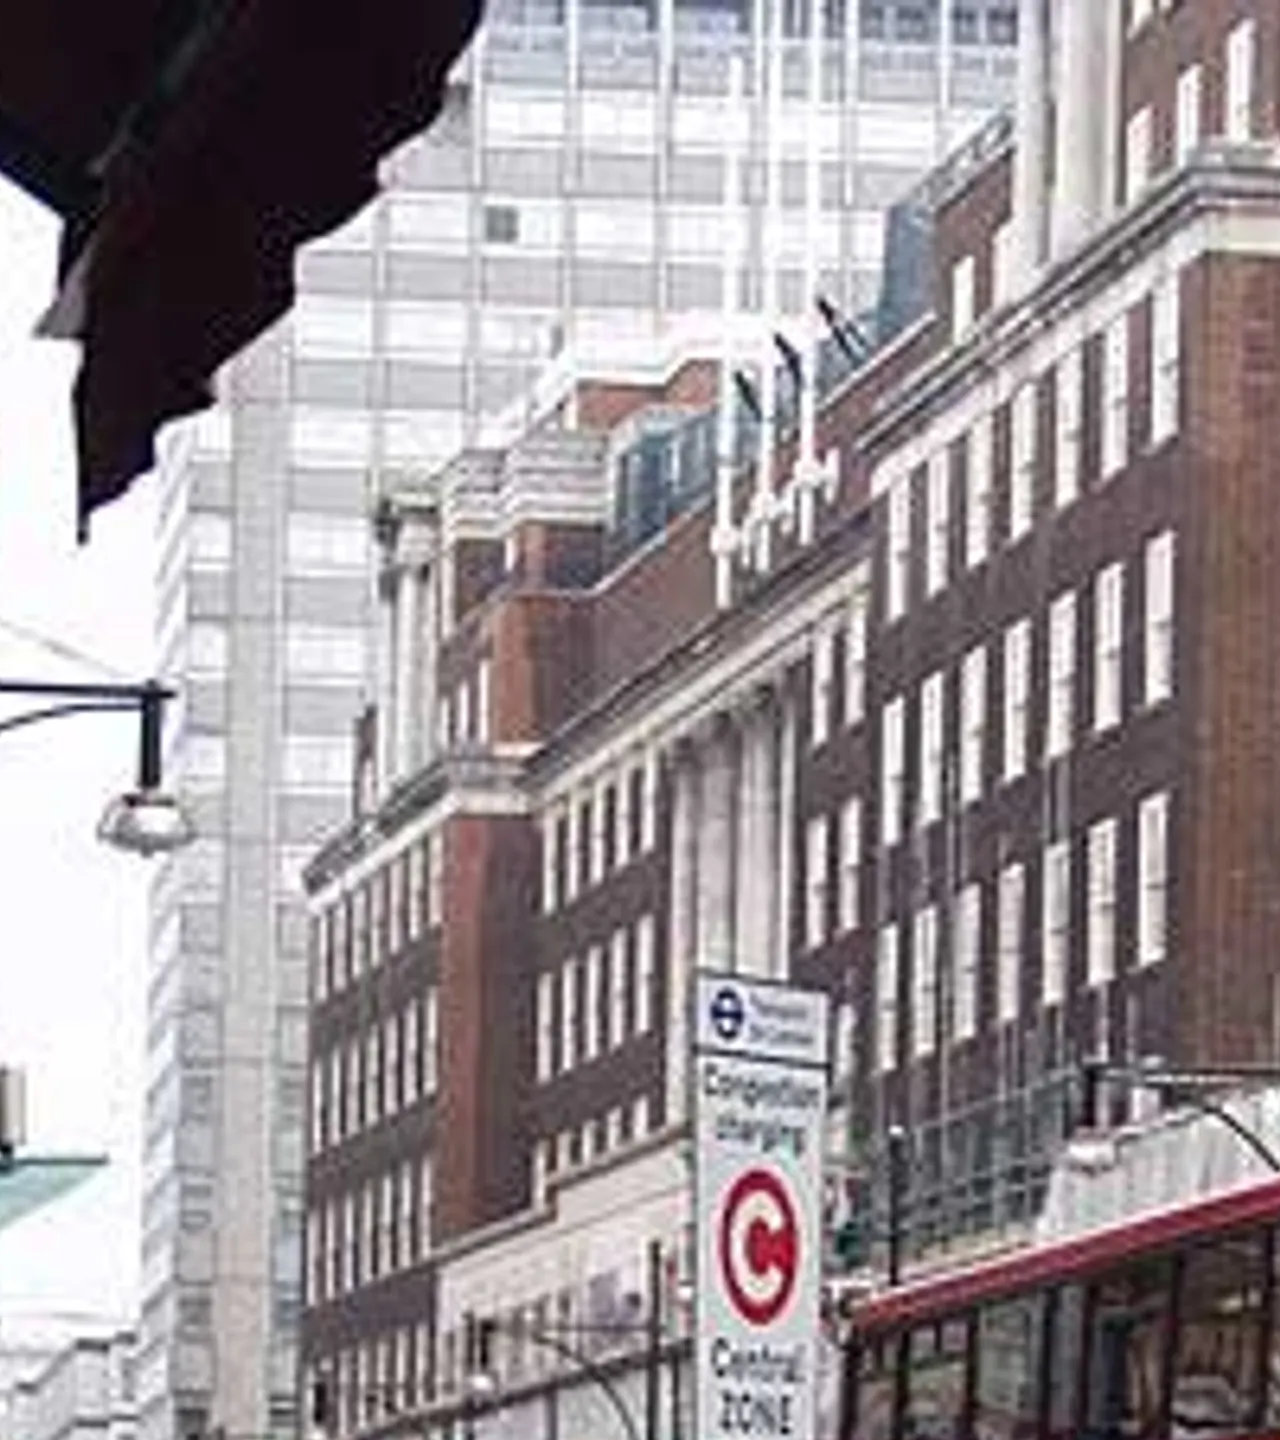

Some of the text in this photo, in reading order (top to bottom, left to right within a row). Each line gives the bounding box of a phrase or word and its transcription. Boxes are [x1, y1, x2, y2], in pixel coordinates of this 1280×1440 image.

[704, 1063, 820, 1109] Congestion
[716, 1115, 807, 1157] charging
[710, 1337, 806, 1383] Central
[719, 1390, 793, 1435] ZONE
